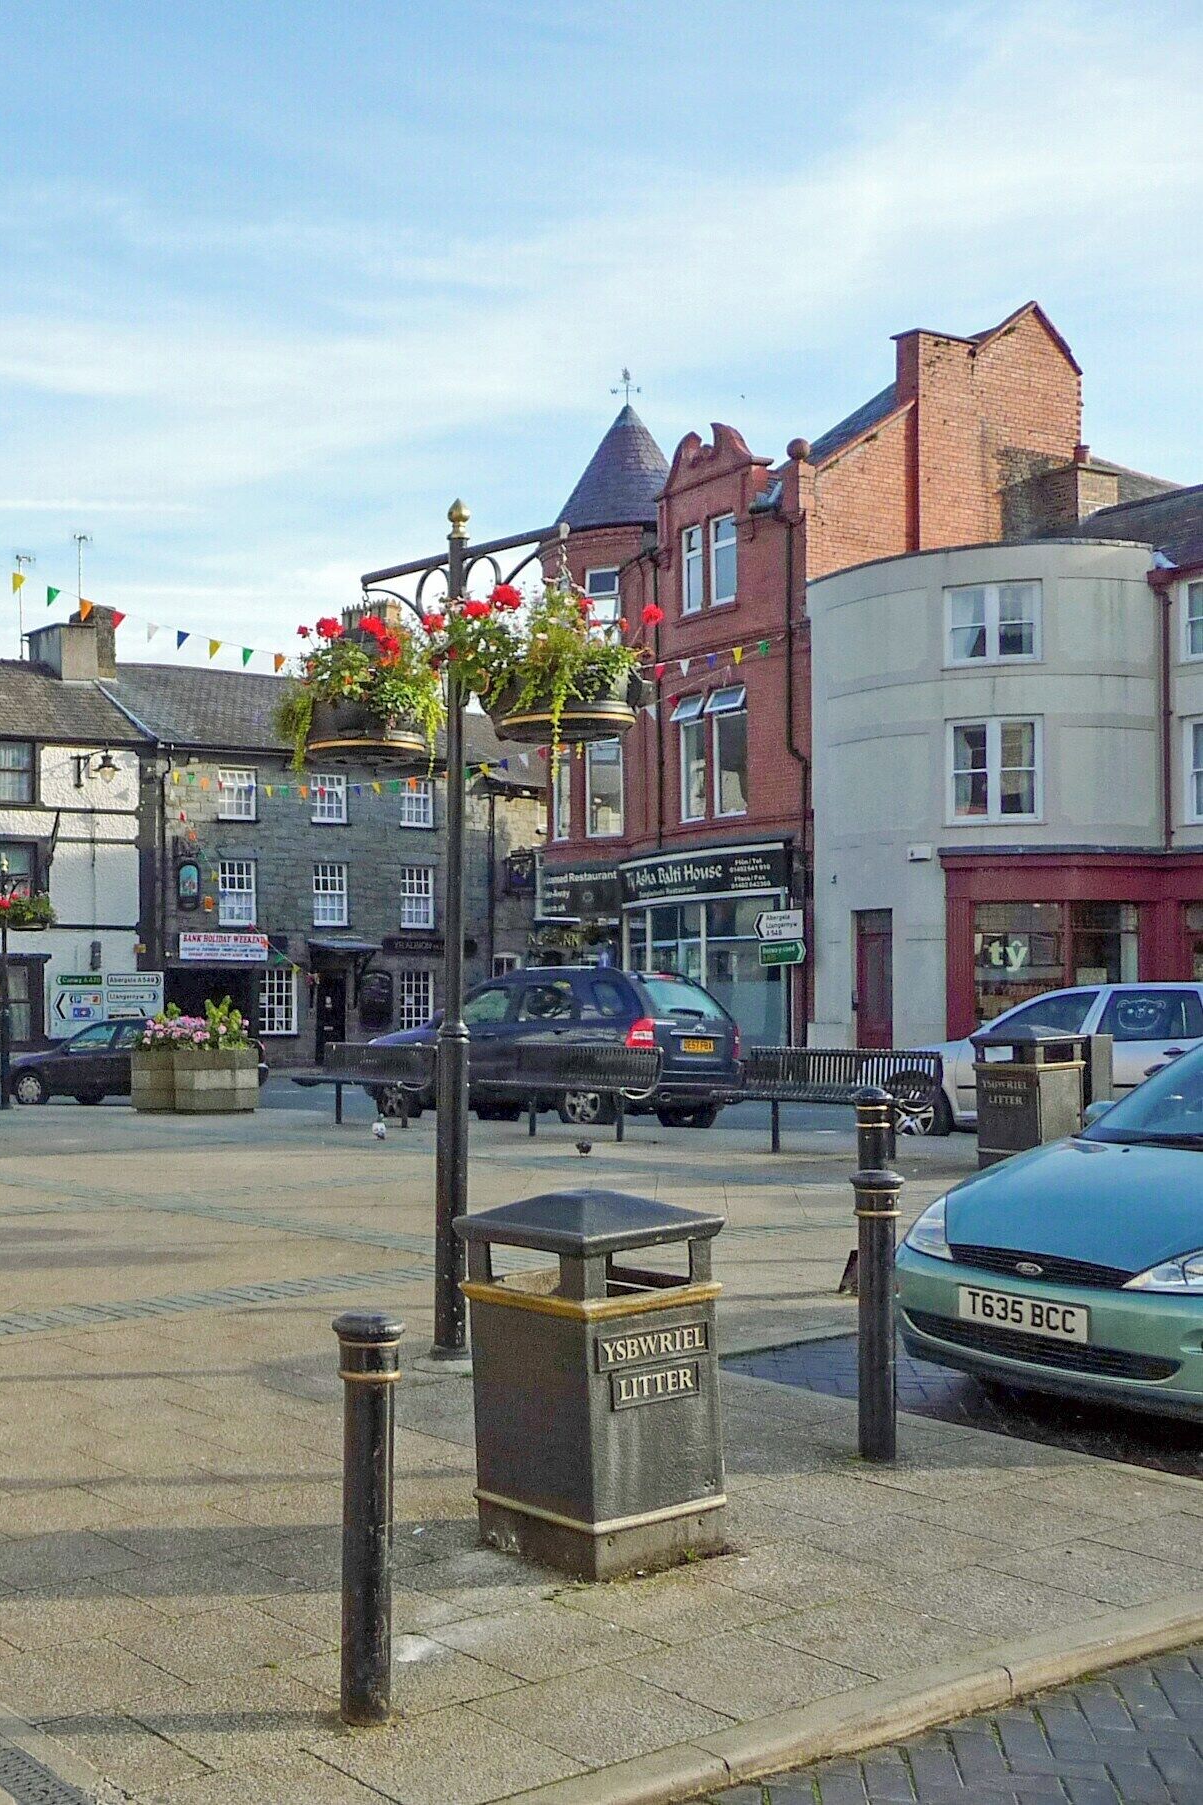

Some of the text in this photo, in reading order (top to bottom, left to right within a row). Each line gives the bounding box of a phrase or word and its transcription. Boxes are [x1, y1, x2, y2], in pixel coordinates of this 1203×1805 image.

[569, 871, 617, 883] Restaurant
[636, 868, 656, 886] Asha
[657, 865, 681, 884] Balti
[684, 863, 722, 881] House
[183, 934, 201, 943] BANK
[203, 934, 231, 943] HOLIDAY
[968, 1291, 1076, 1334] T635 BCC
[602, 1327, 705, 1363] YSBWRIEL
[619, 1368, 694, 1400] LITTER
